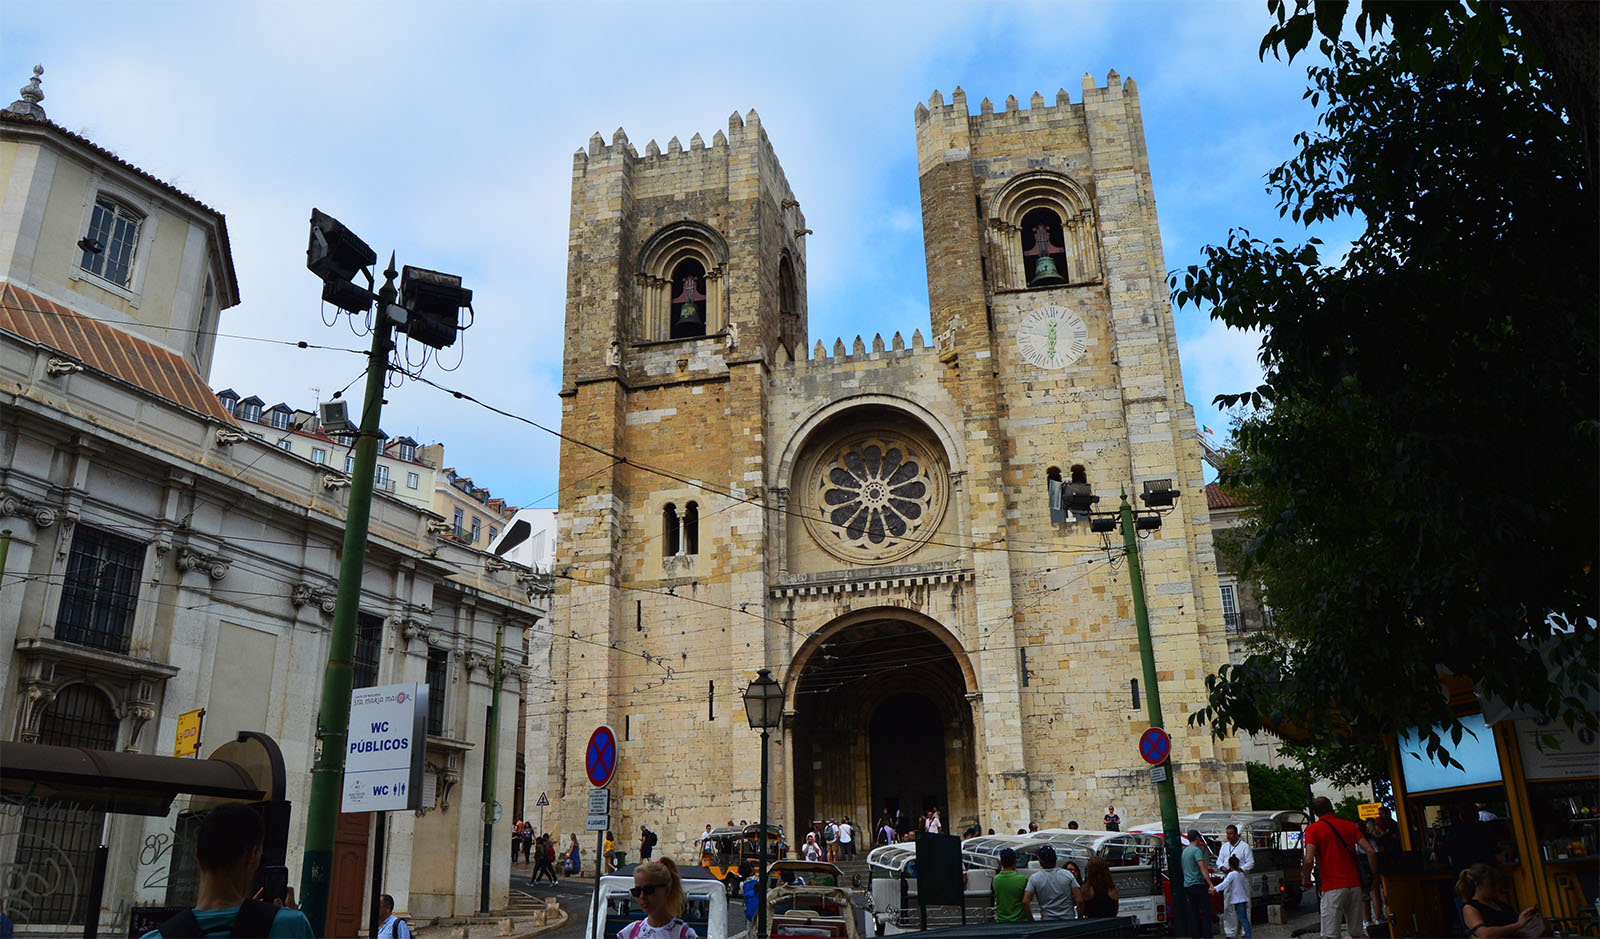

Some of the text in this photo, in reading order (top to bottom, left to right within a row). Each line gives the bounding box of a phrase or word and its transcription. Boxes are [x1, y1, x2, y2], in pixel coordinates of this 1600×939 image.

[371, 721, 389, 733] WC
[350, 738, 409, 754] PÚBLICOS
[373, 785, 389, 796] WC
